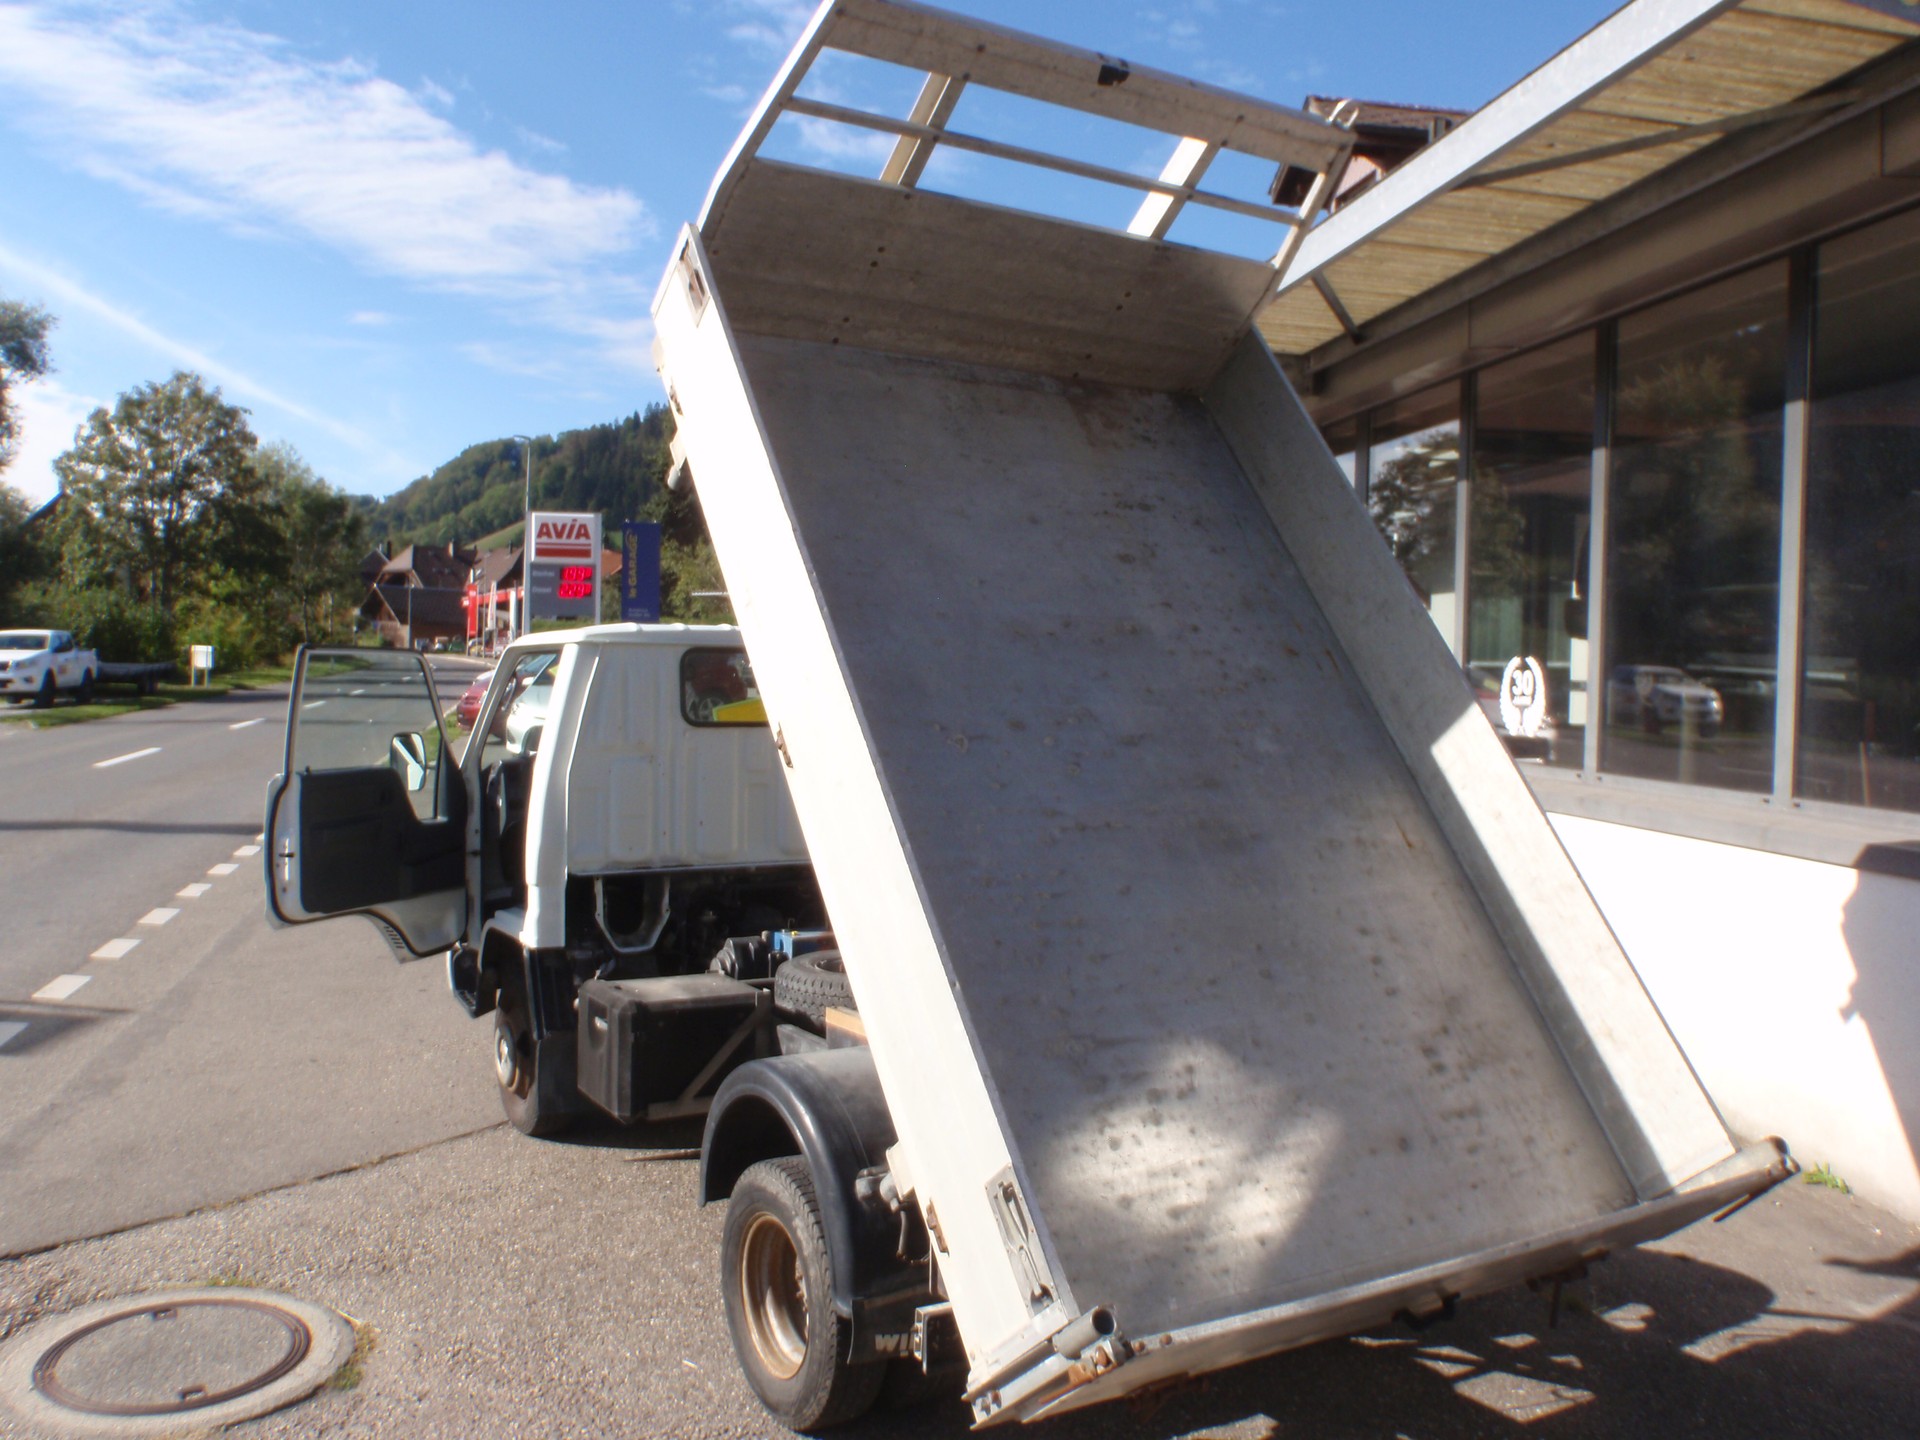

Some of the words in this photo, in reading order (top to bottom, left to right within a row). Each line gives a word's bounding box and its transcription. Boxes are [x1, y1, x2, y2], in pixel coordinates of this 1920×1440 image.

[536, 518, 591, 540] AViA
[628, 534, 637, 586] GARAGE
[1512, 669, 1534, 696] 30
